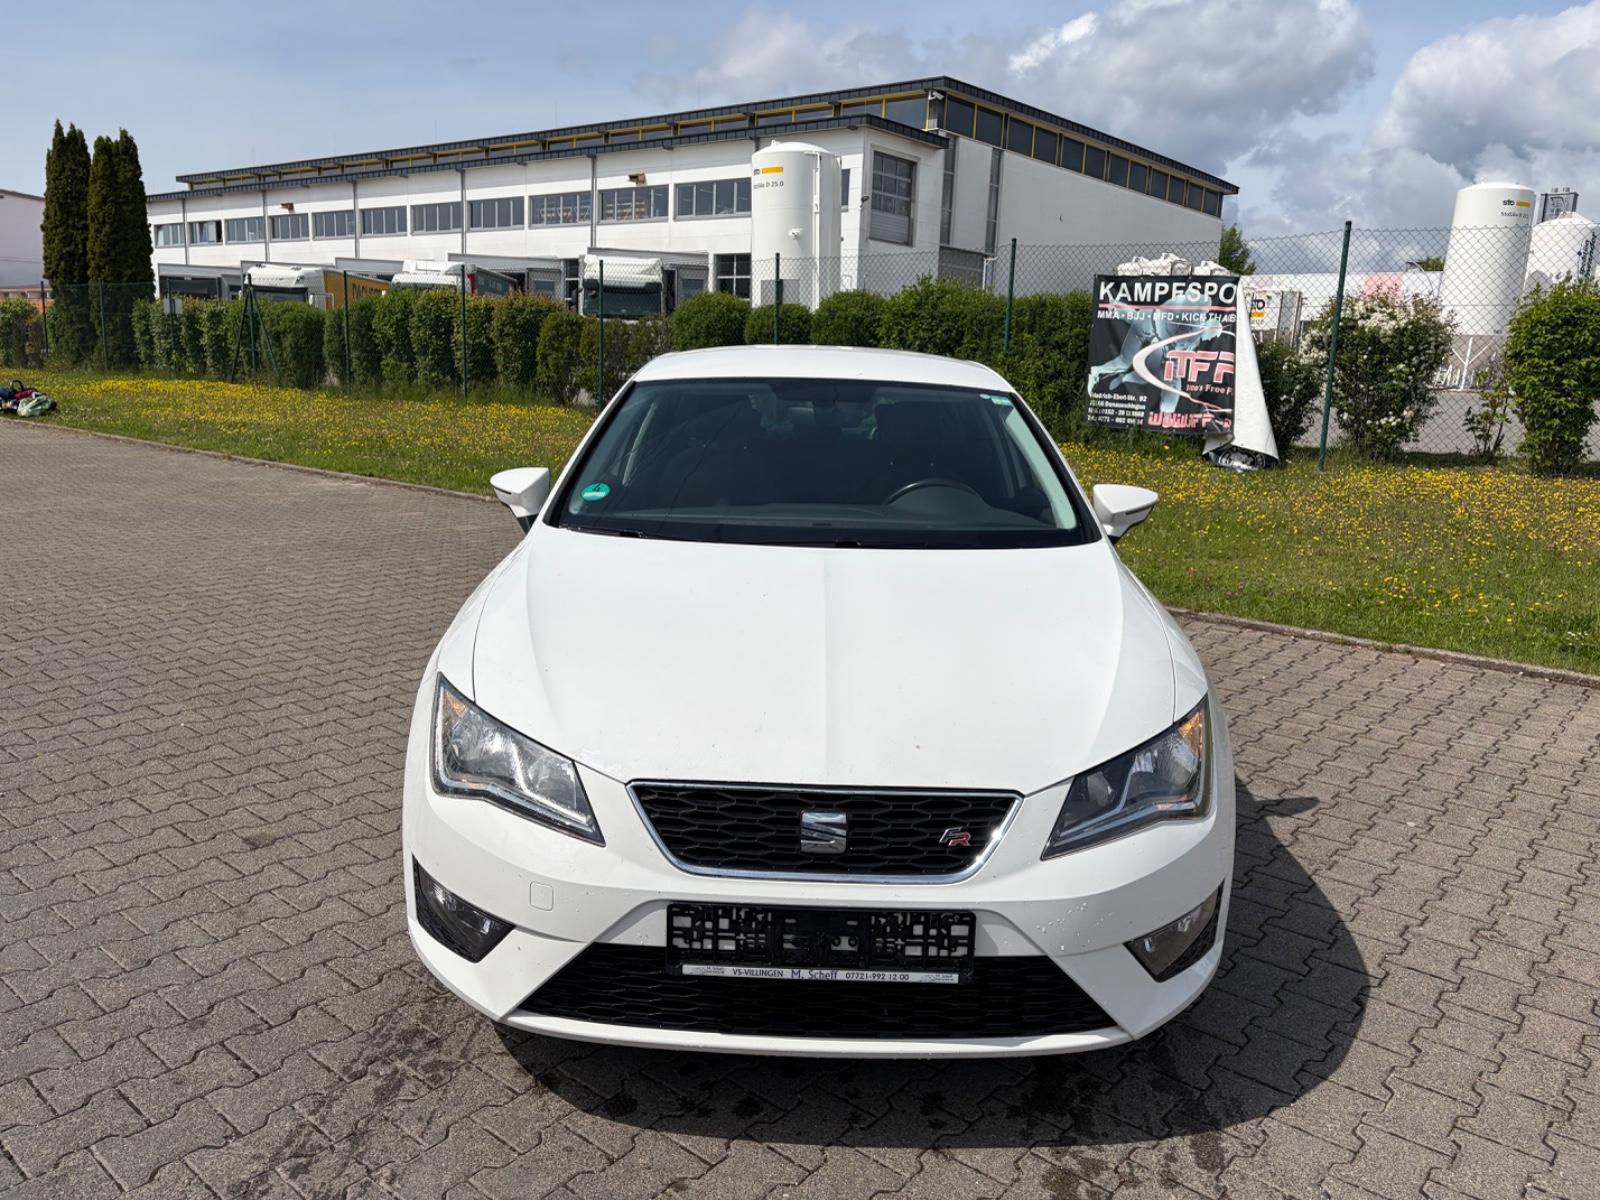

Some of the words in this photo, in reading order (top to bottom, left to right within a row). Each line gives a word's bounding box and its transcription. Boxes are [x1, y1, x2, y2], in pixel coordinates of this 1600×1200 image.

[1097, 310, 1120, 319] MMA
[939, 827, 972, 847] FR
[732, 967, 784, 978] VS-VILLINGEN
[791, 969, 804, 979] M.
[808, 969, 838, 980] Scheff
